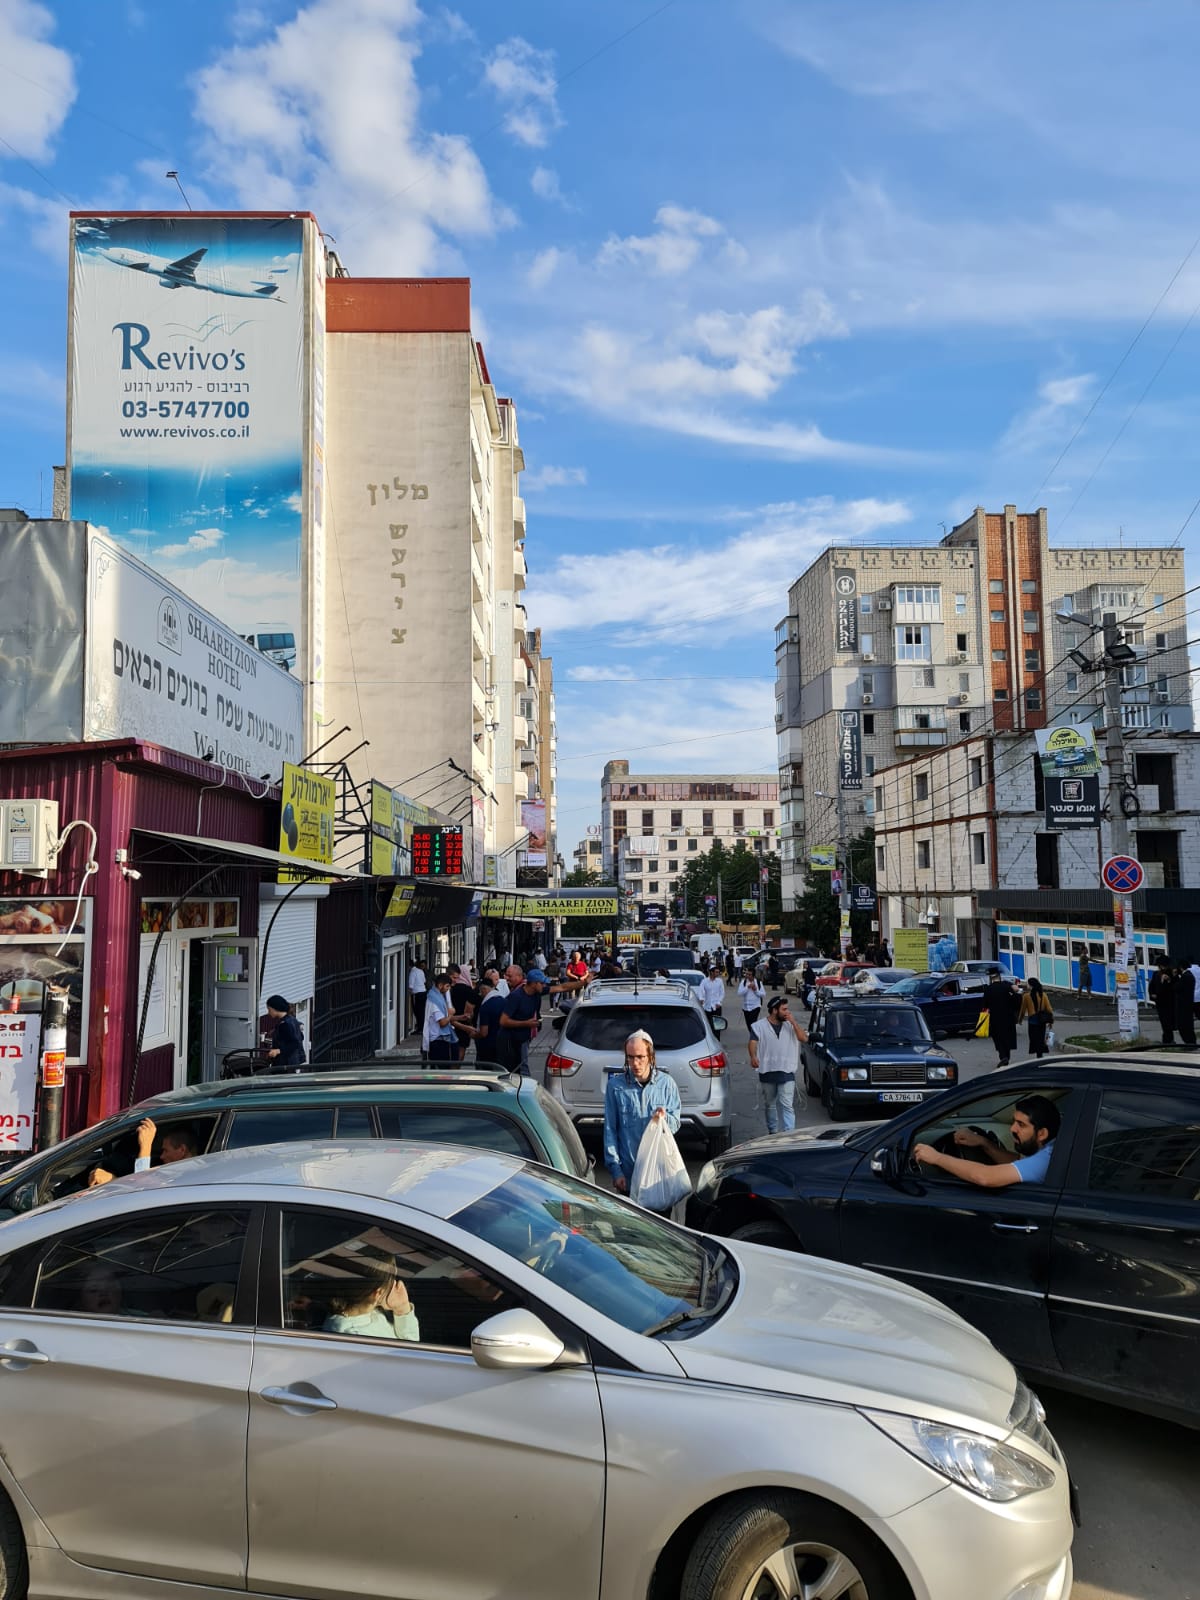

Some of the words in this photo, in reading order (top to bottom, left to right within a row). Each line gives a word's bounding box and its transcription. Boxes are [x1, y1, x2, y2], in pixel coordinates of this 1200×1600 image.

[112, 322, 246, 370] Revivo's
[124, 382, 152, 393] רגוע
[156, 380, 193, 393] להגיע
[207, 382, 250, 393] רביבוס
[122, 400, 250, 418] 03-5747700
[120, 425, 250, 438] www.revivos.co.il
[366, 476, 429, 506] מלון
[187, 613, 234, 663] SHAAREI
[235, 652, 257, 679] ZION
[113, 638, 162, 694] הבאים
[207, 652, 242, 691] HOTEL
[167, 667, 208, 716] ברוכים
[216, 693, 243, 732] שמח
[247, 710, 282, 750] שבועות
[285, 730, 295, 755] חג
[193, 731, 251, 774] Welcome
[290, 769, 331, 807] יארמולקע
[1050, 804, 1074, 812] סנטר
[1076, 804, 1096, 813] אומן
[586, 899, 614, 907] ZION
